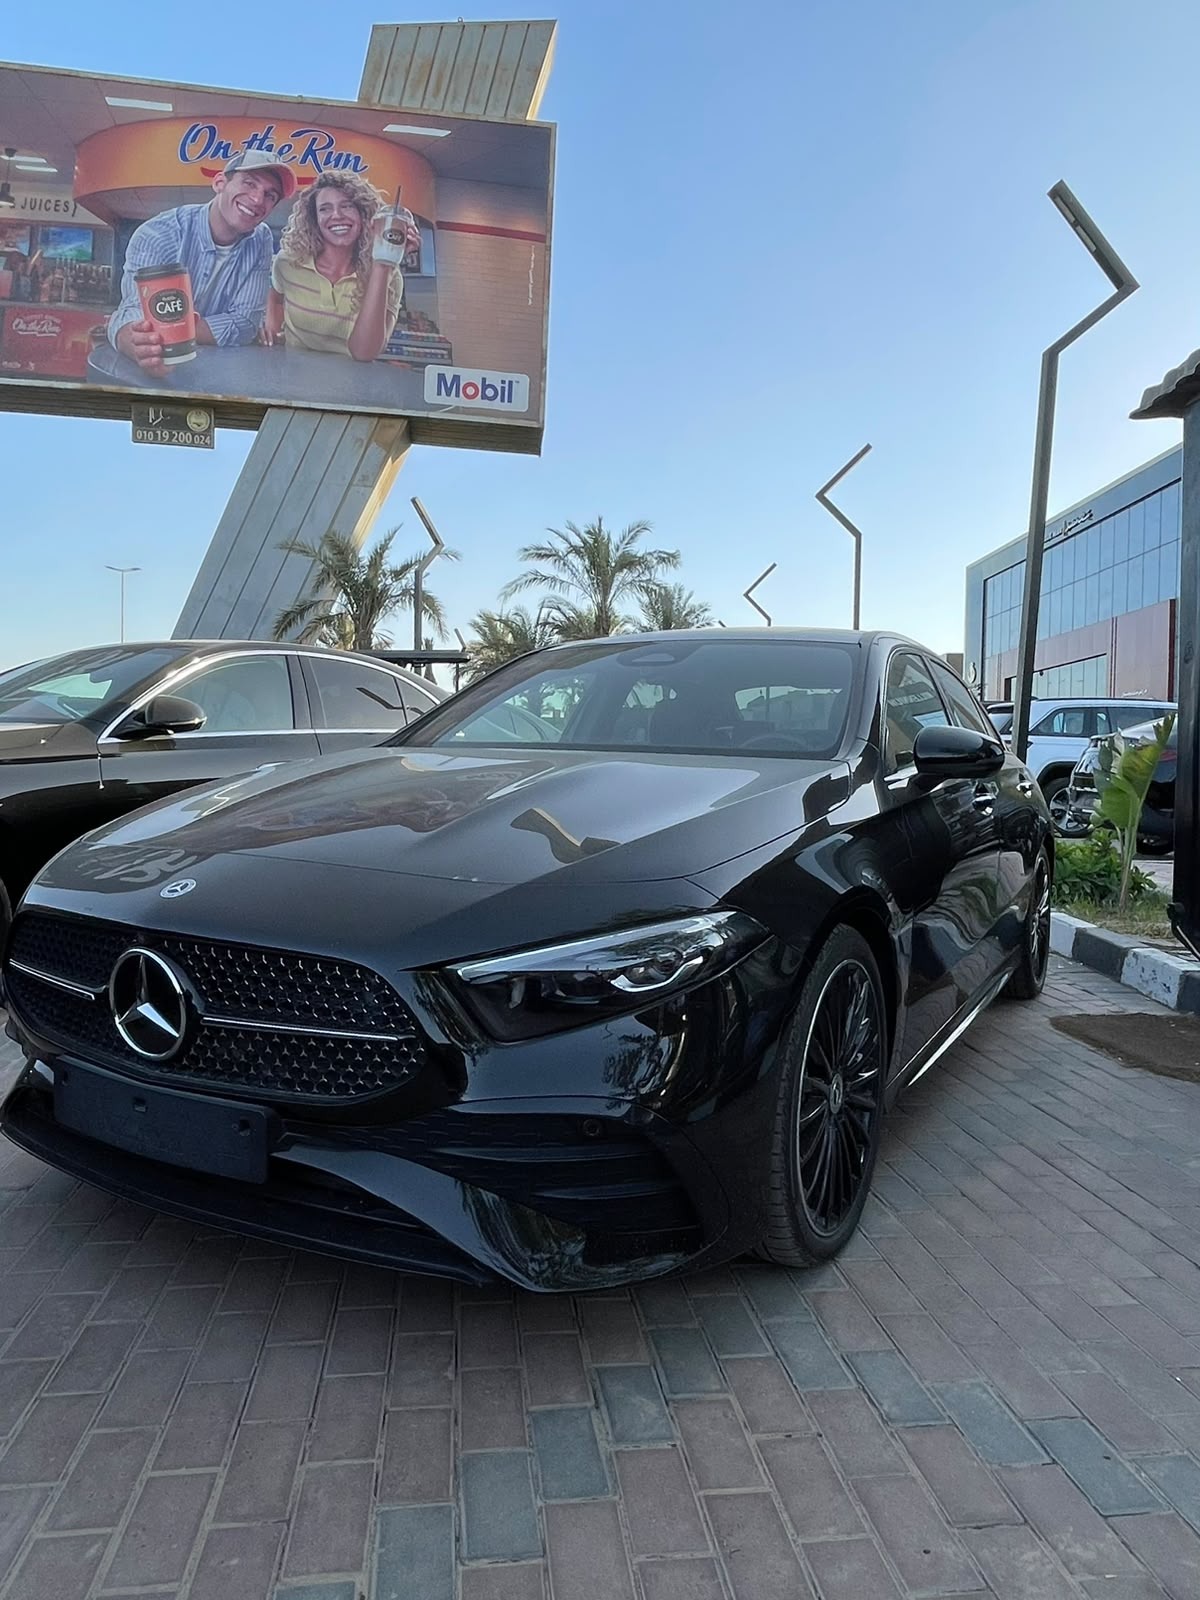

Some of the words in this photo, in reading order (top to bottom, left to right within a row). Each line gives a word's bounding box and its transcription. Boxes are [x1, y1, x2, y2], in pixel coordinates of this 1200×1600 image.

[179, 123, 239, 163] On
[242, 126, 297, 162] the
[290, 129, 369, 173] Run
[436, 372, 514, 404] Mobil
[136, 429, 154, 441] 010
[155, 430, 170, 442] 19
[171, 431, 192, 444] 200
[193, 434, 211, 445] 024
